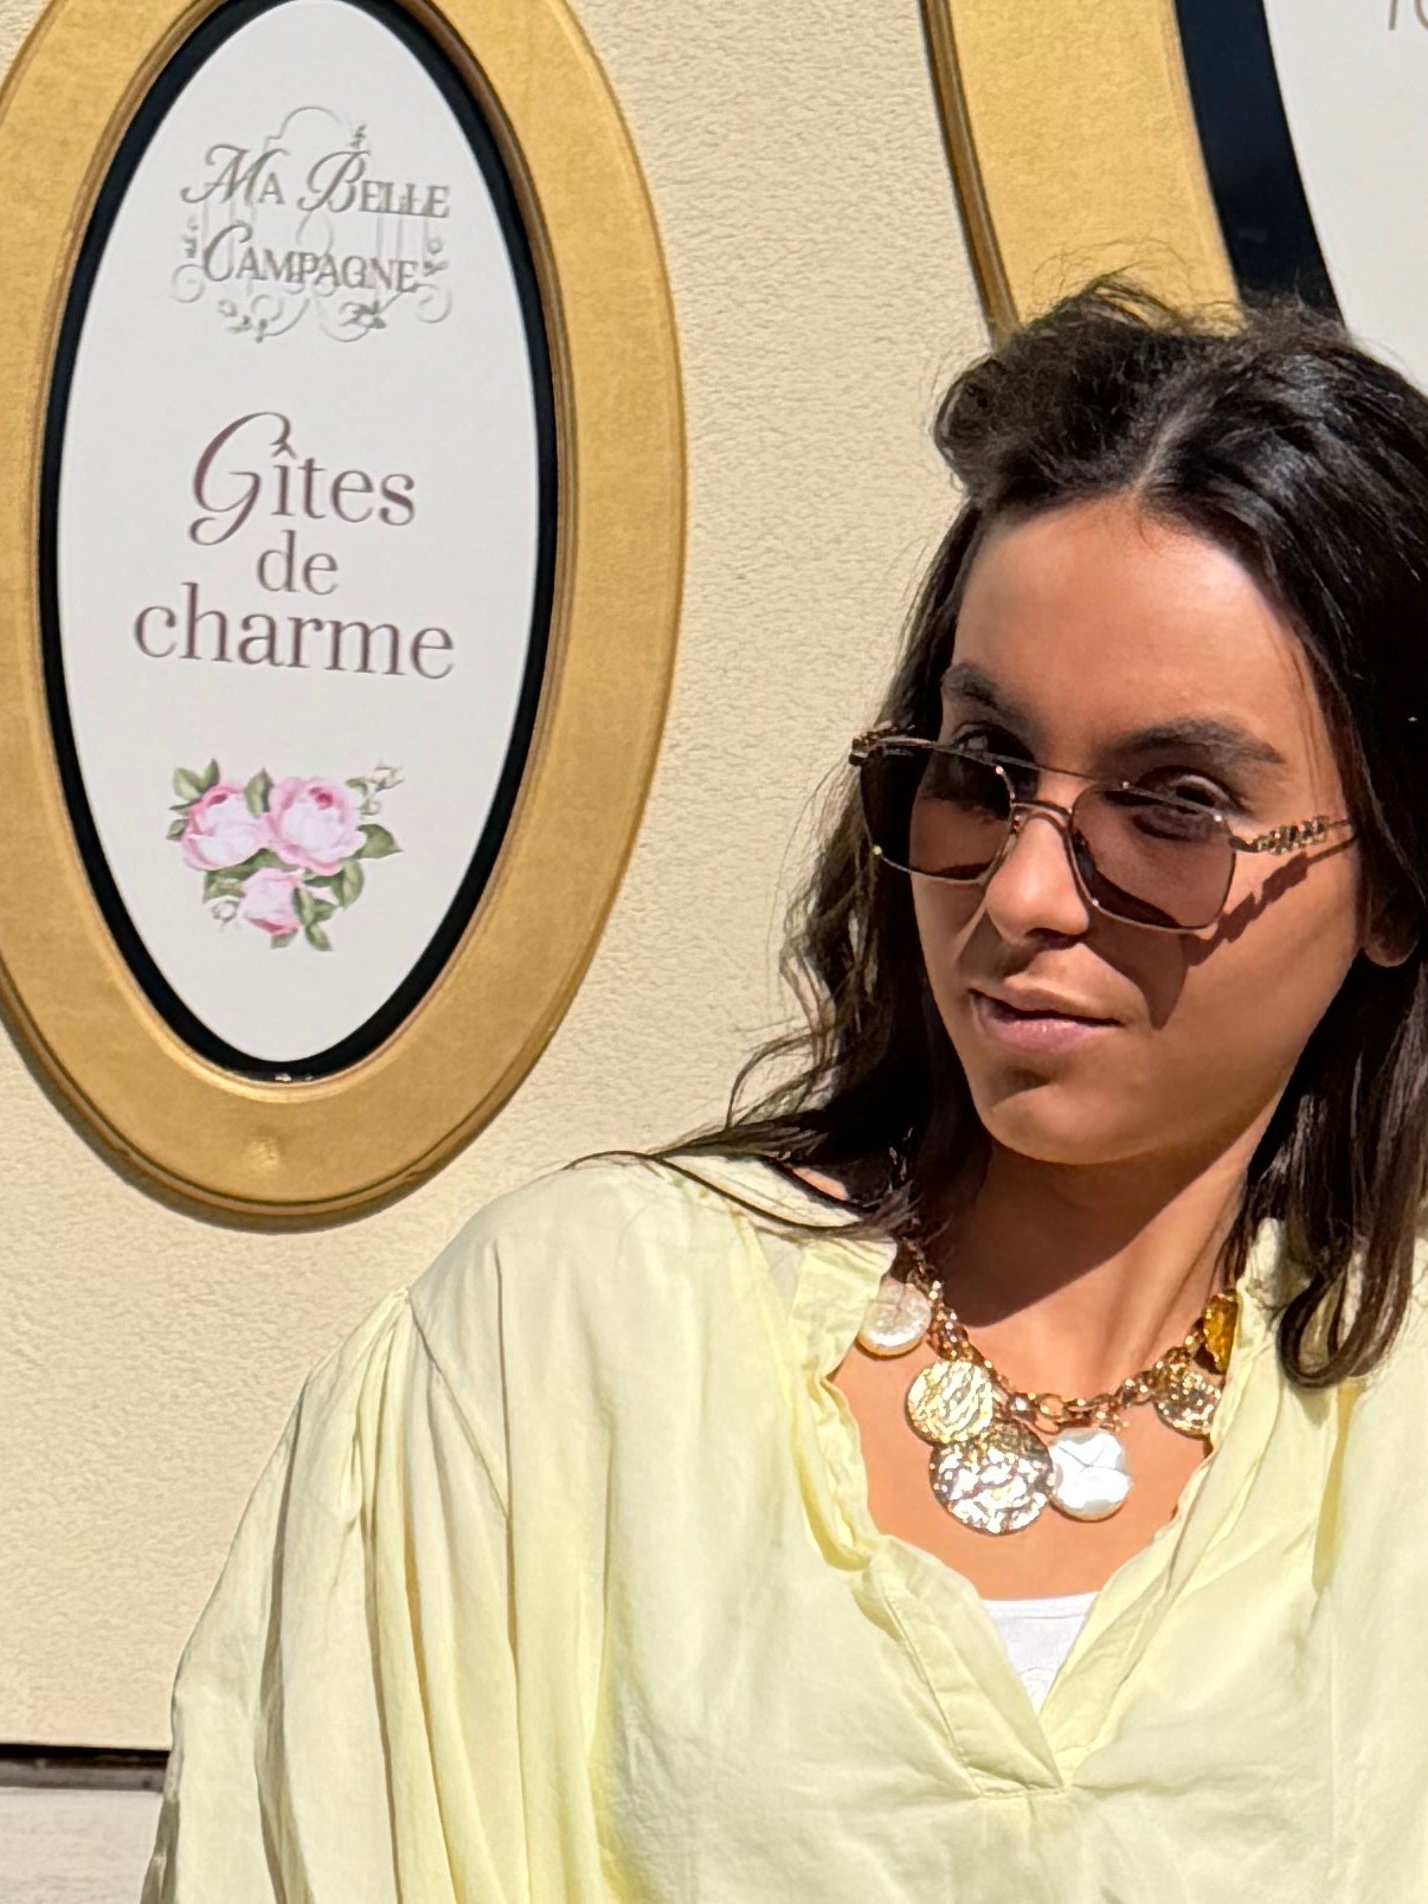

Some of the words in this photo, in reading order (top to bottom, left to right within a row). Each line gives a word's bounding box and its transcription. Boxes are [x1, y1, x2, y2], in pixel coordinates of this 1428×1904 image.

[188, 411, 416, 546] Gîtes
[256, 530, 339, 596] de
[133, 582, 454, 680] charme
